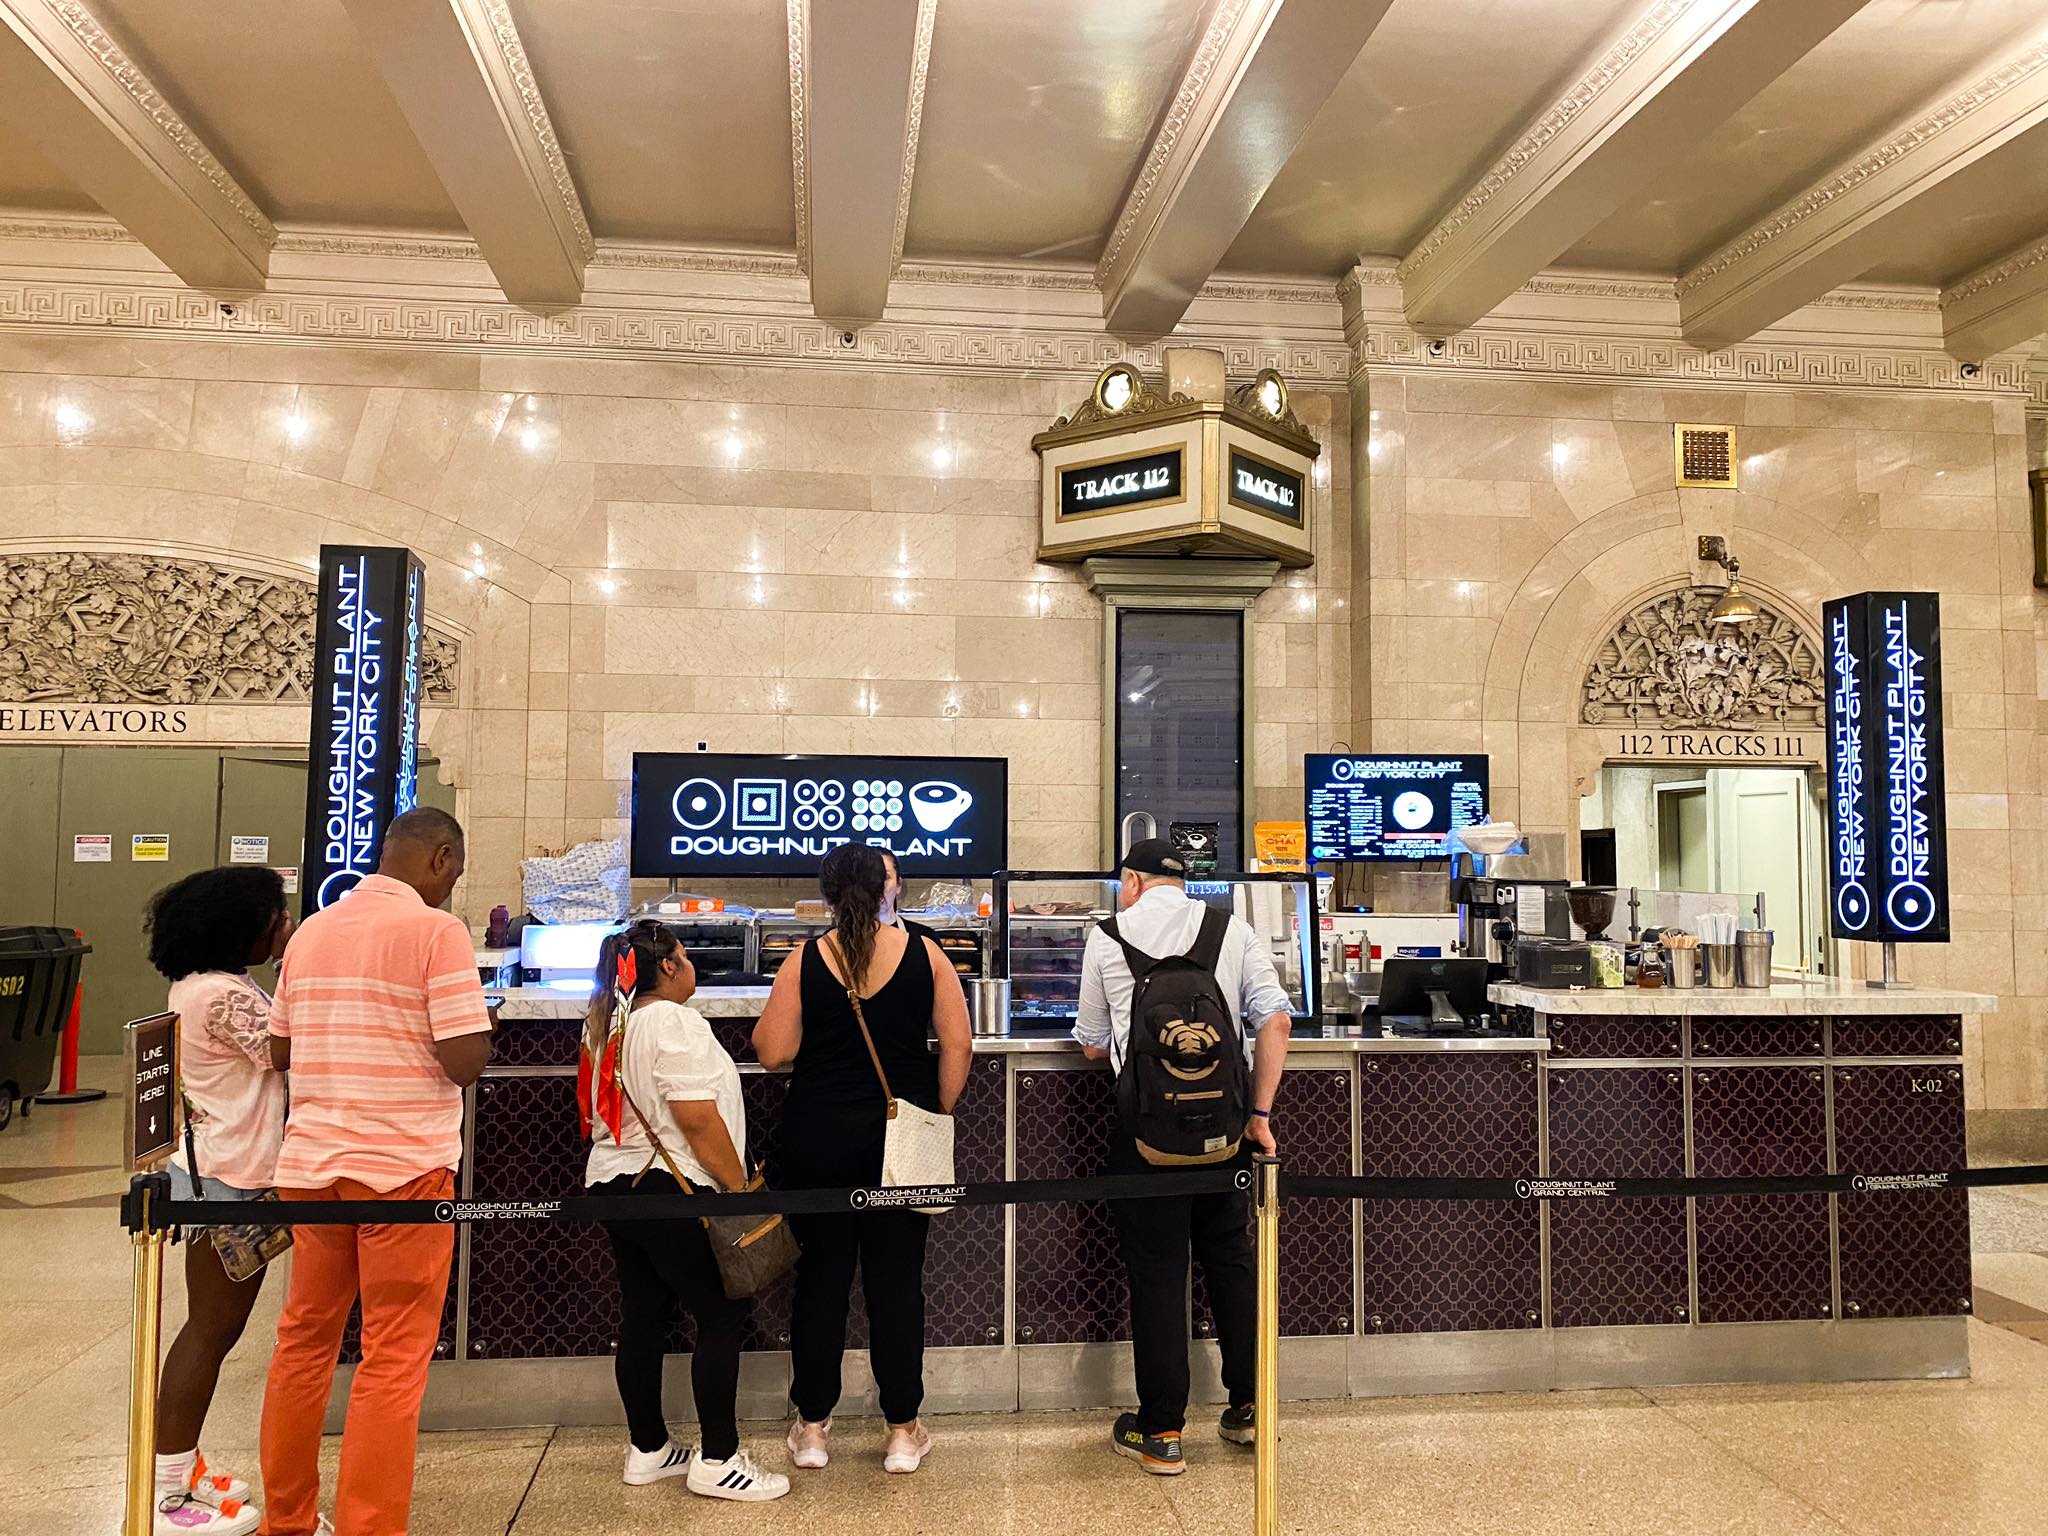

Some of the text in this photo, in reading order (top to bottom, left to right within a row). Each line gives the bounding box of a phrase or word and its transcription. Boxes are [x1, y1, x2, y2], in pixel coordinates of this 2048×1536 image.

[1073, 467, 1170, 501] TRACK 112
[1236, 469, 1295, 507] TRACK 112
[0, 709, 187, 733] ELEVATORS
[326, 563, 358, 863] DOUGHNUT PLANT
[353, 609, 383, 864] NEW YORK CITY
[1619, 735, 1804, 757] 112 TRACKS 111
[1886, 608, 1907, 876] DOUGHNUT PLANT
[1833, 617, 1852, 877] DOUGHNUT PLANT
[1354, 761, 1463, 769] DOUGHNUT PLANT
[1848, 652, 1866, 877] NEW YORK CITY
[1908, 648, 1929, 876] NEW YORK CITY
[1354, 771, 1446, 779] NEW YORK CITY
[1185, 884, 1230, 895] 11:15 AM
[143, 1045, 163, 1062] LINE
[136, 1063, 170, 1085] STARTS
[140, 1085, 165, 1104] HERE!
[1911, 1079, 1943, 1093] K-02
[1867, 1174, 1915, 1183] DOUGHNUT
[870, 1186, 967, 1198] DOUGHNUT PLANT
[870, 1196, 957, 1207] GRAND CENTRAL
[1533, 1189, 1610, 1197] GRAND CENTRAL
[456, 1201, 561, 1211] DOUGHNUT PLANT
[456, 1211, 551, 1220] GRAND CENTRAL
